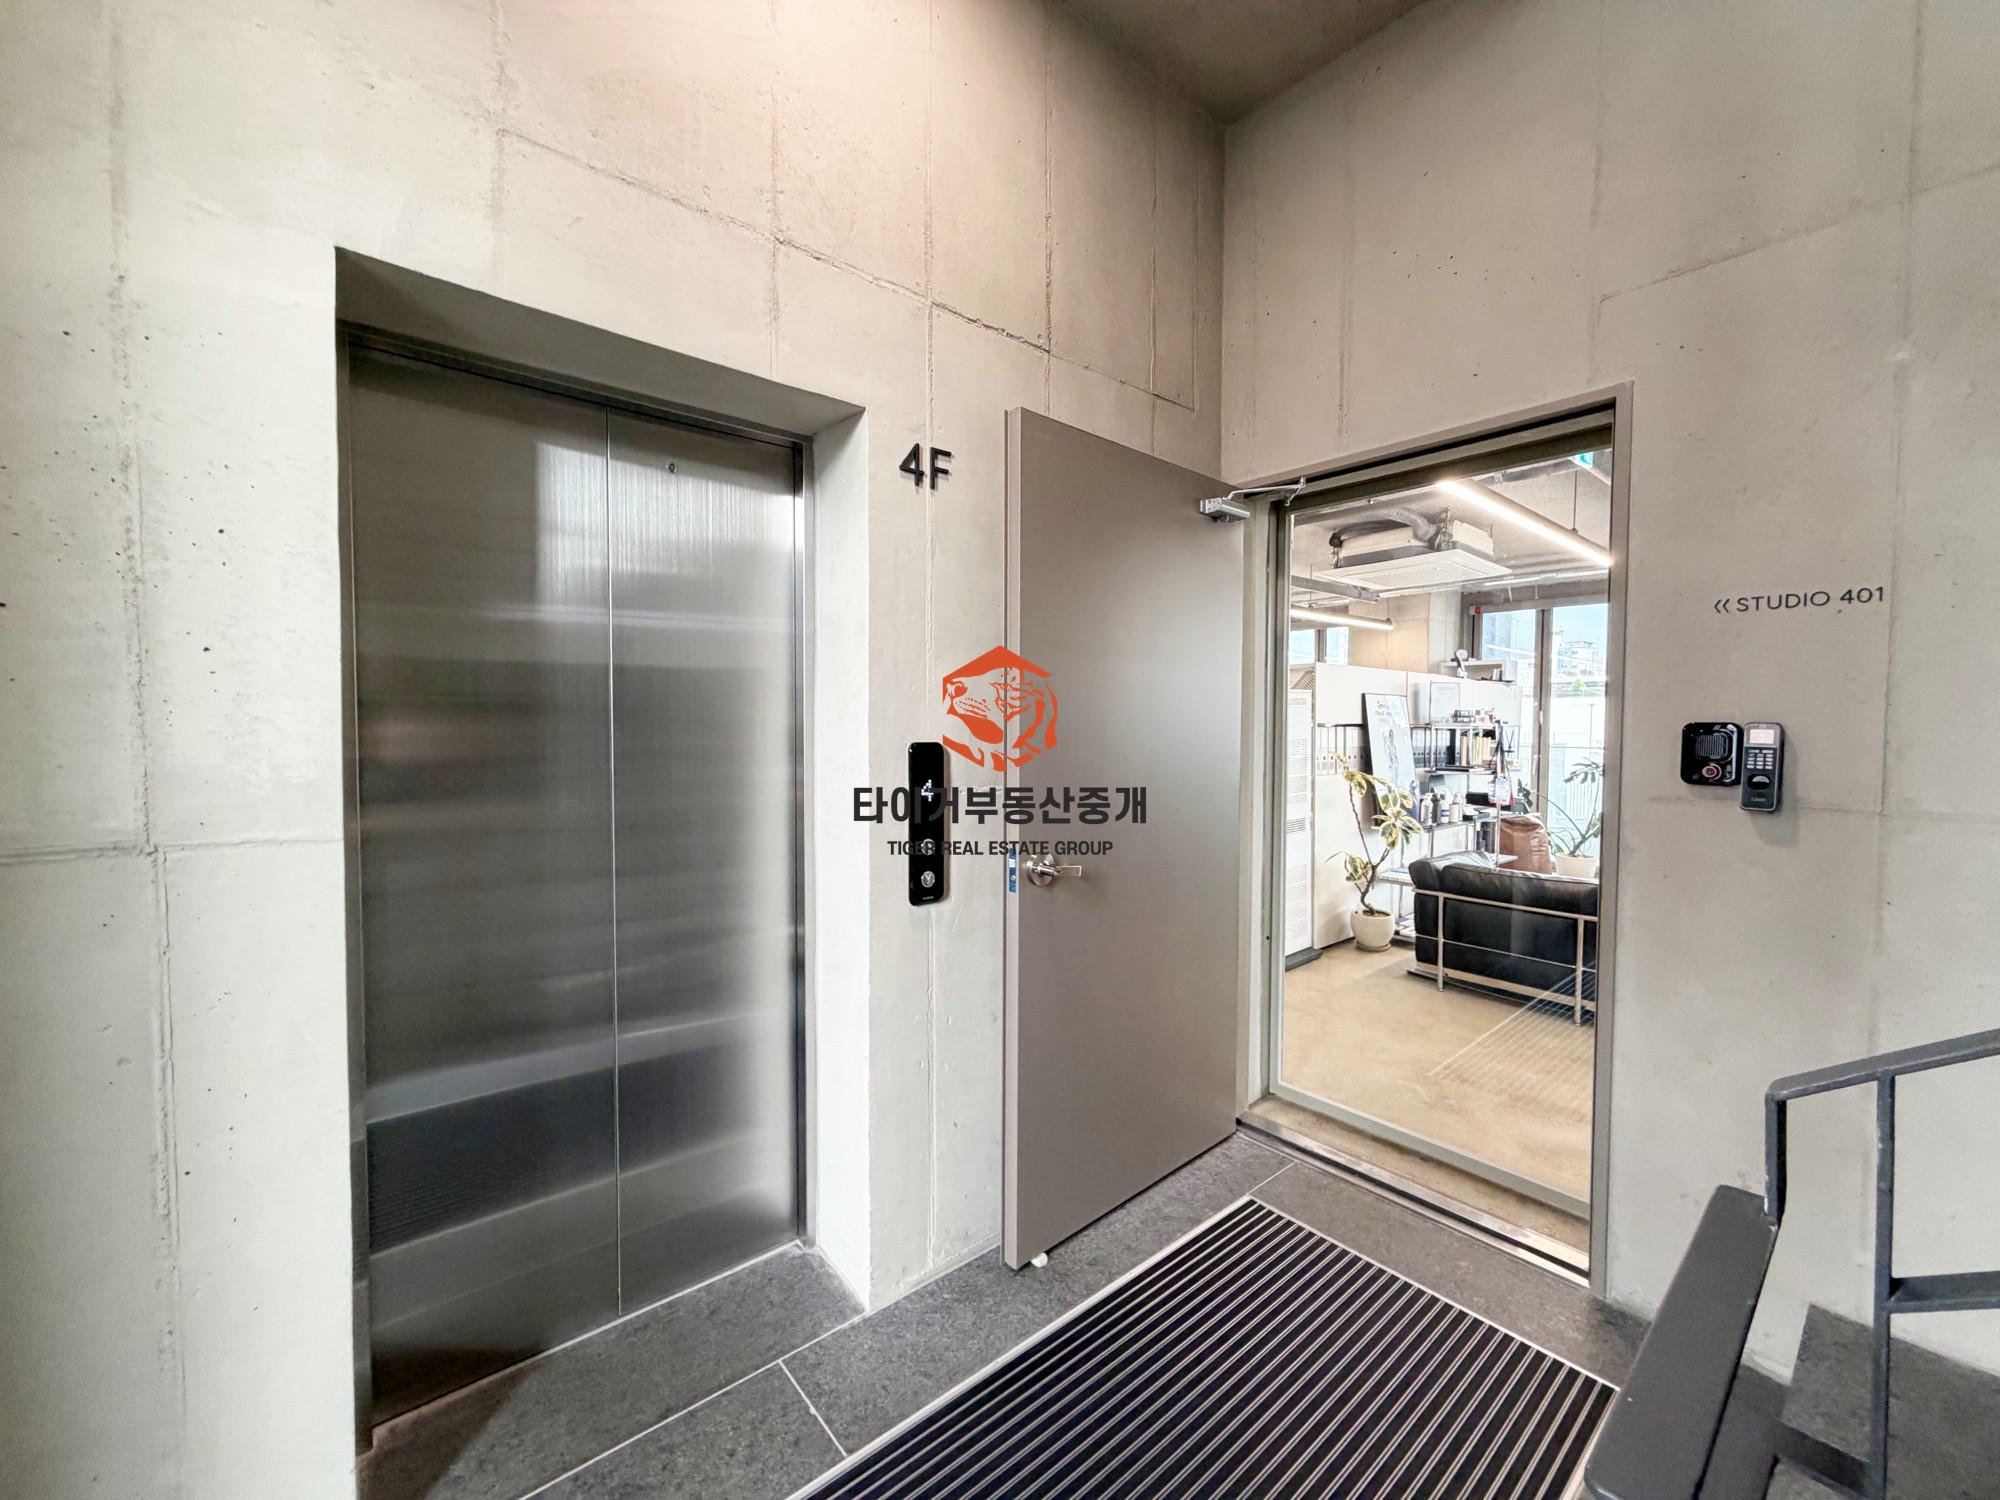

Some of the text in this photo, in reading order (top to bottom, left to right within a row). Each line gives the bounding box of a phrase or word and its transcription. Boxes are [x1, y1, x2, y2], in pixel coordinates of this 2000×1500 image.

[899, 443, 952, 490] 4F
[1736, 586, 1884, 612] STUDIO 401
[921, 779, 934, 802] 4
